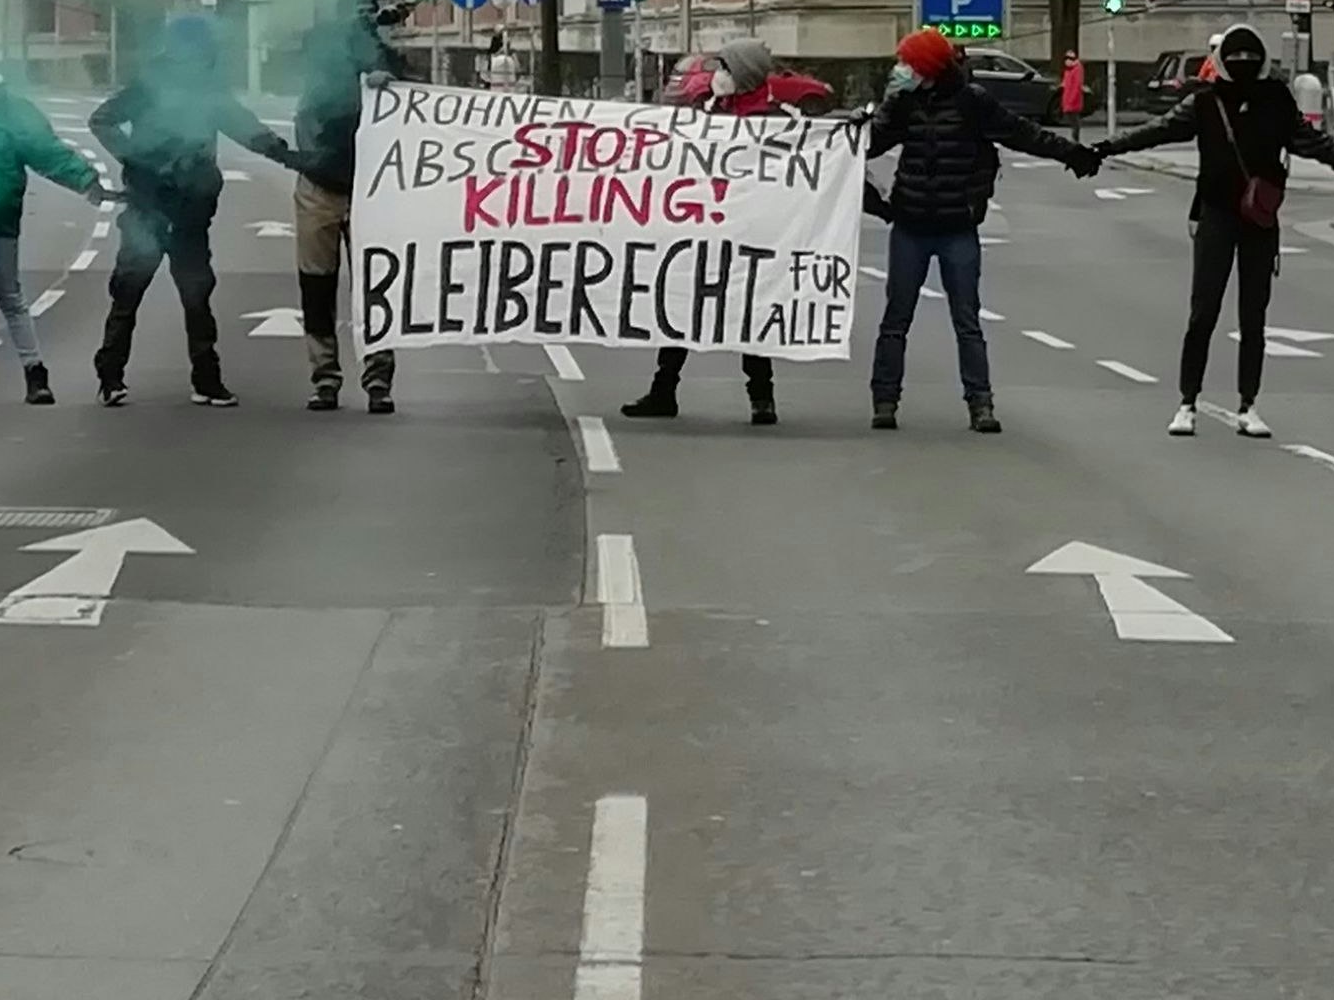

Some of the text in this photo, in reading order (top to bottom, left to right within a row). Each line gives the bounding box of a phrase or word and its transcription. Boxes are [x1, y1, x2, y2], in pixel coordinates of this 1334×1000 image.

[372, 86, 594, 128] DROHNEN
[510, 121, 670, 171] STOP
[464, 175, 730, 233] KILLING!
[363, 238, 852, 345] BLEIBERECHT FÜR
[757, 299, 846, 346] ALLE
